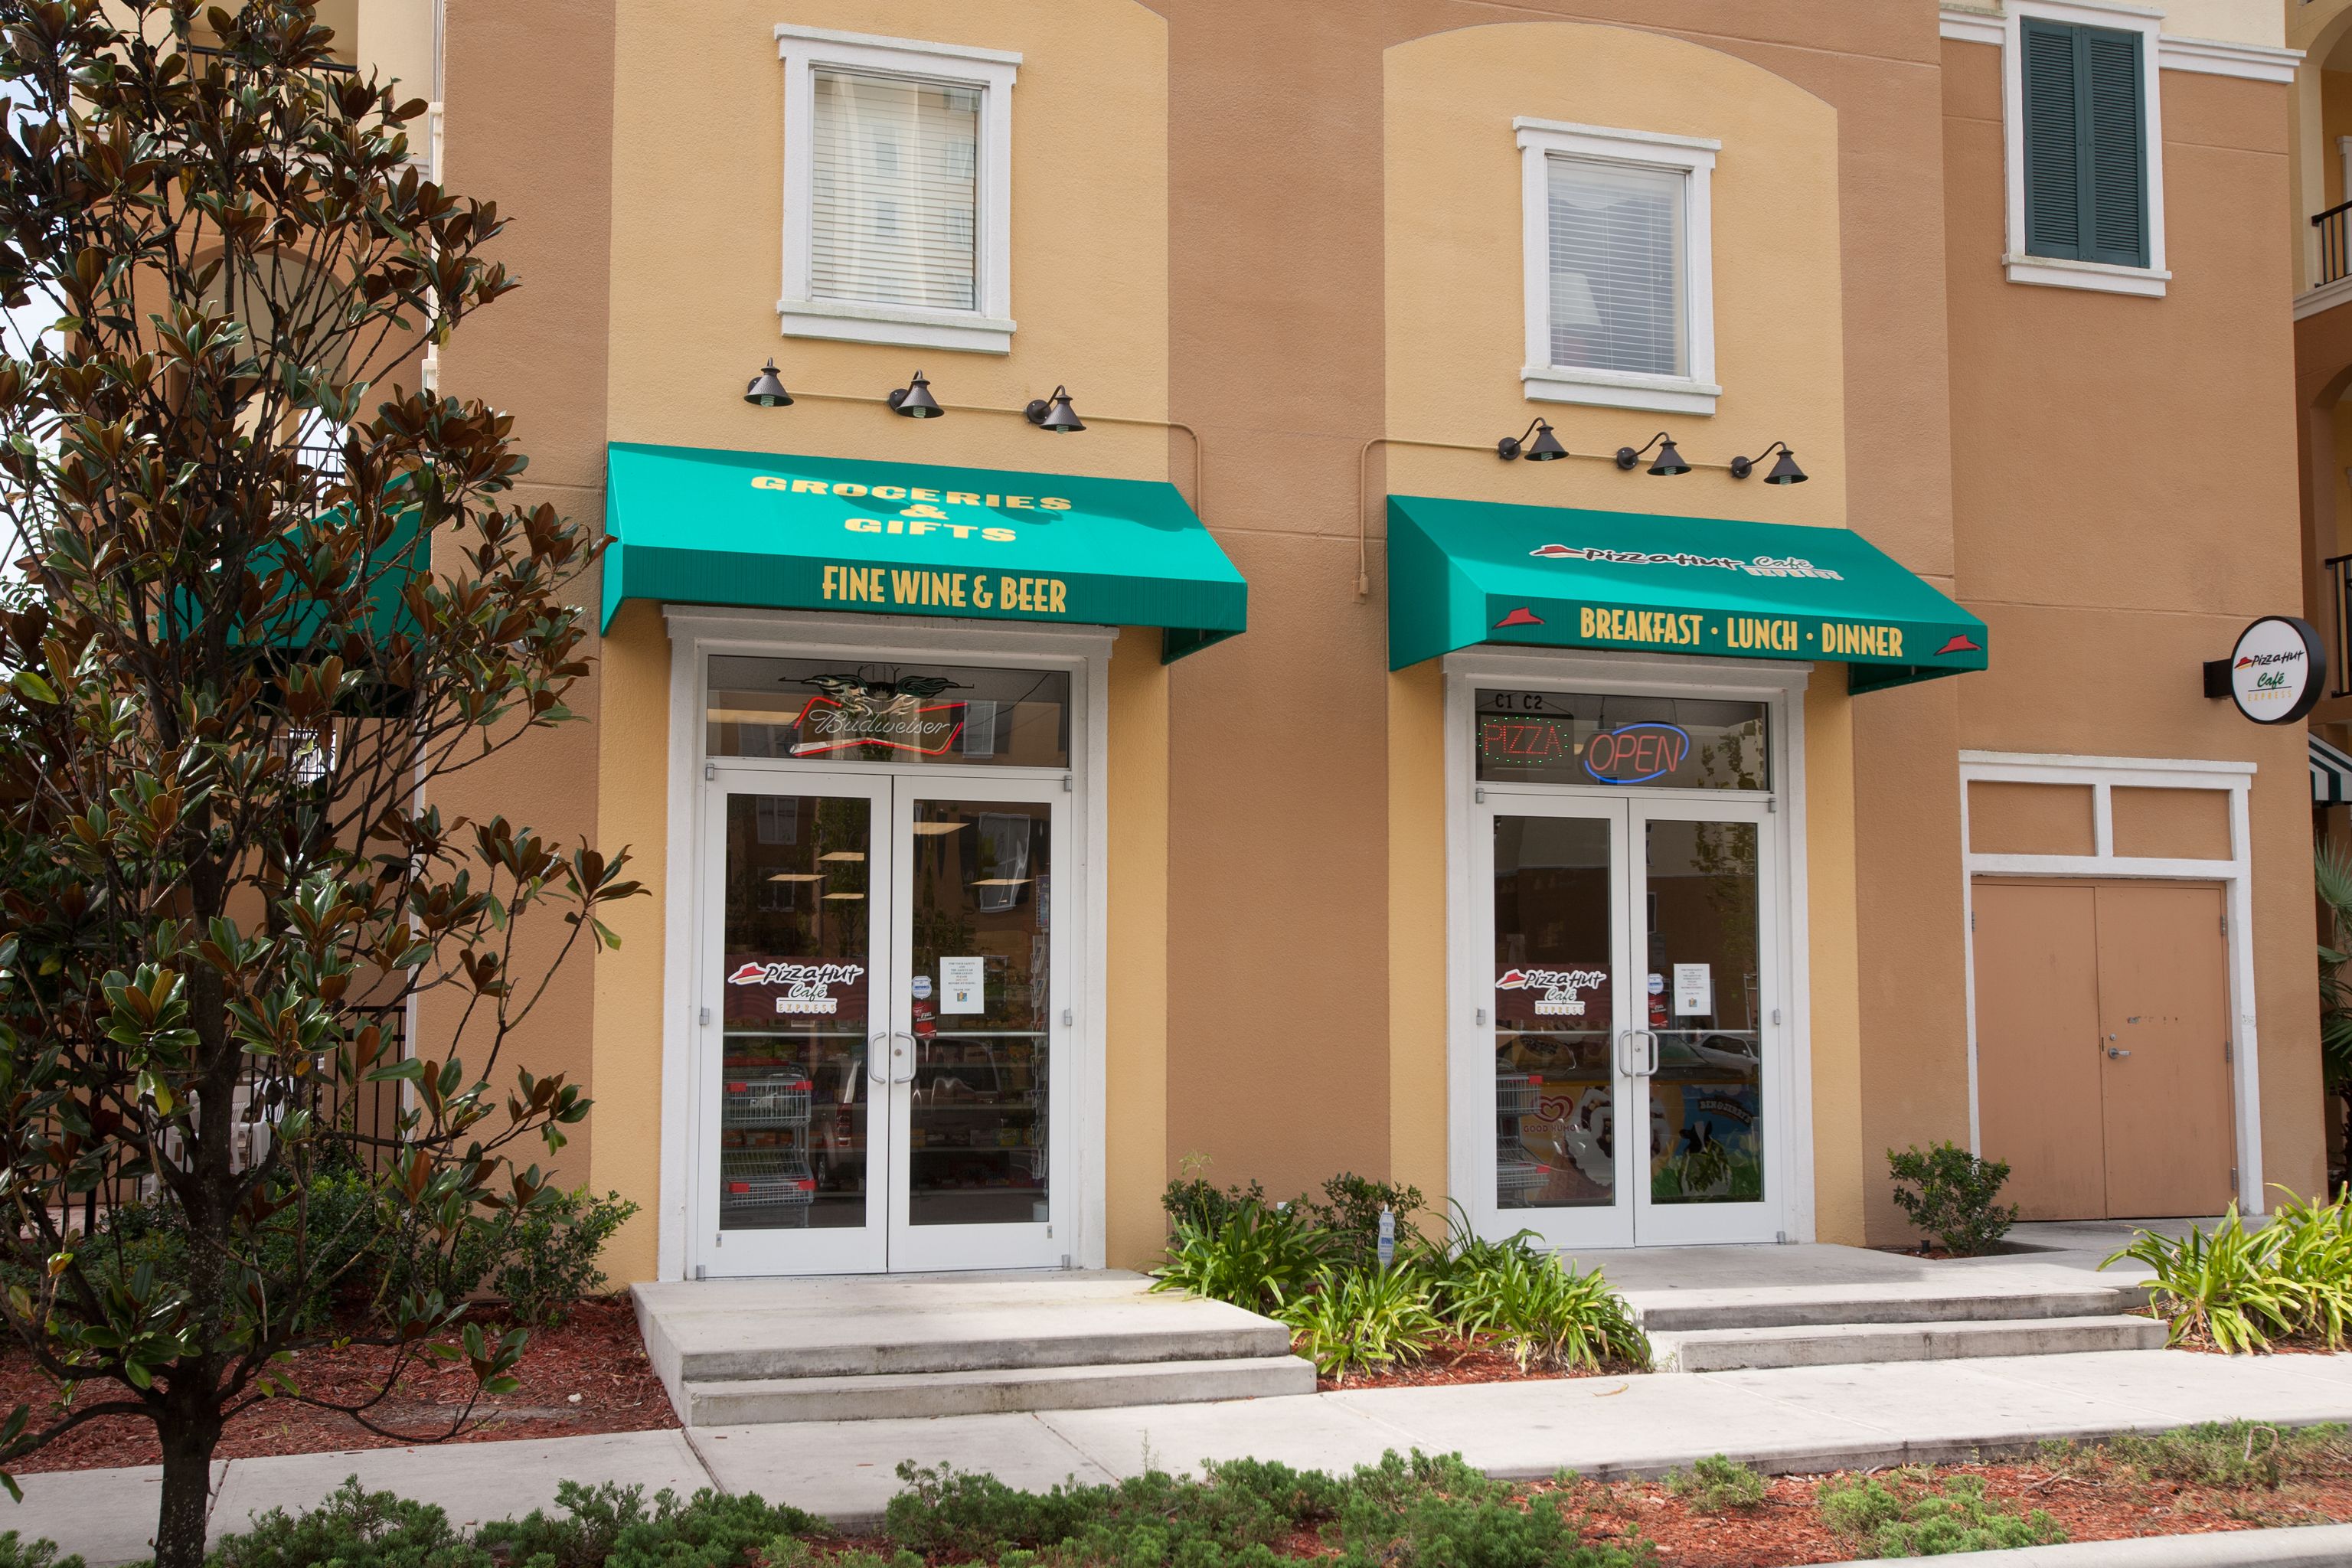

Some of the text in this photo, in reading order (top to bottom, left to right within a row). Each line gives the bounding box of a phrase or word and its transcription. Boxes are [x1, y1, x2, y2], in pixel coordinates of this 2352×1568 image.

[750, 475, 1072, 511] GROCERIES
[900, 504, 949, 520] &
[844, 518, 1017, 542] GIFTS
[822, 565, 1067, 613] FINE WINE & BEER
[1580, 607, 1903, 658] BREAKFAST LUNCH DINNER
[2257, 671, 2285, 688] Café
[1495, 694, 1543, 710] C1 C2
[808, 709, 950, 734] Budweiser
[1485, 724, 1562, 755] PIZZA
[1589, 734, 1681, 773] OPEN
[790, 985, 827, 1002] Café
[1547, 988, 1576, 1004] Café
[778, 1003, 836, 1012] EXPRESS
